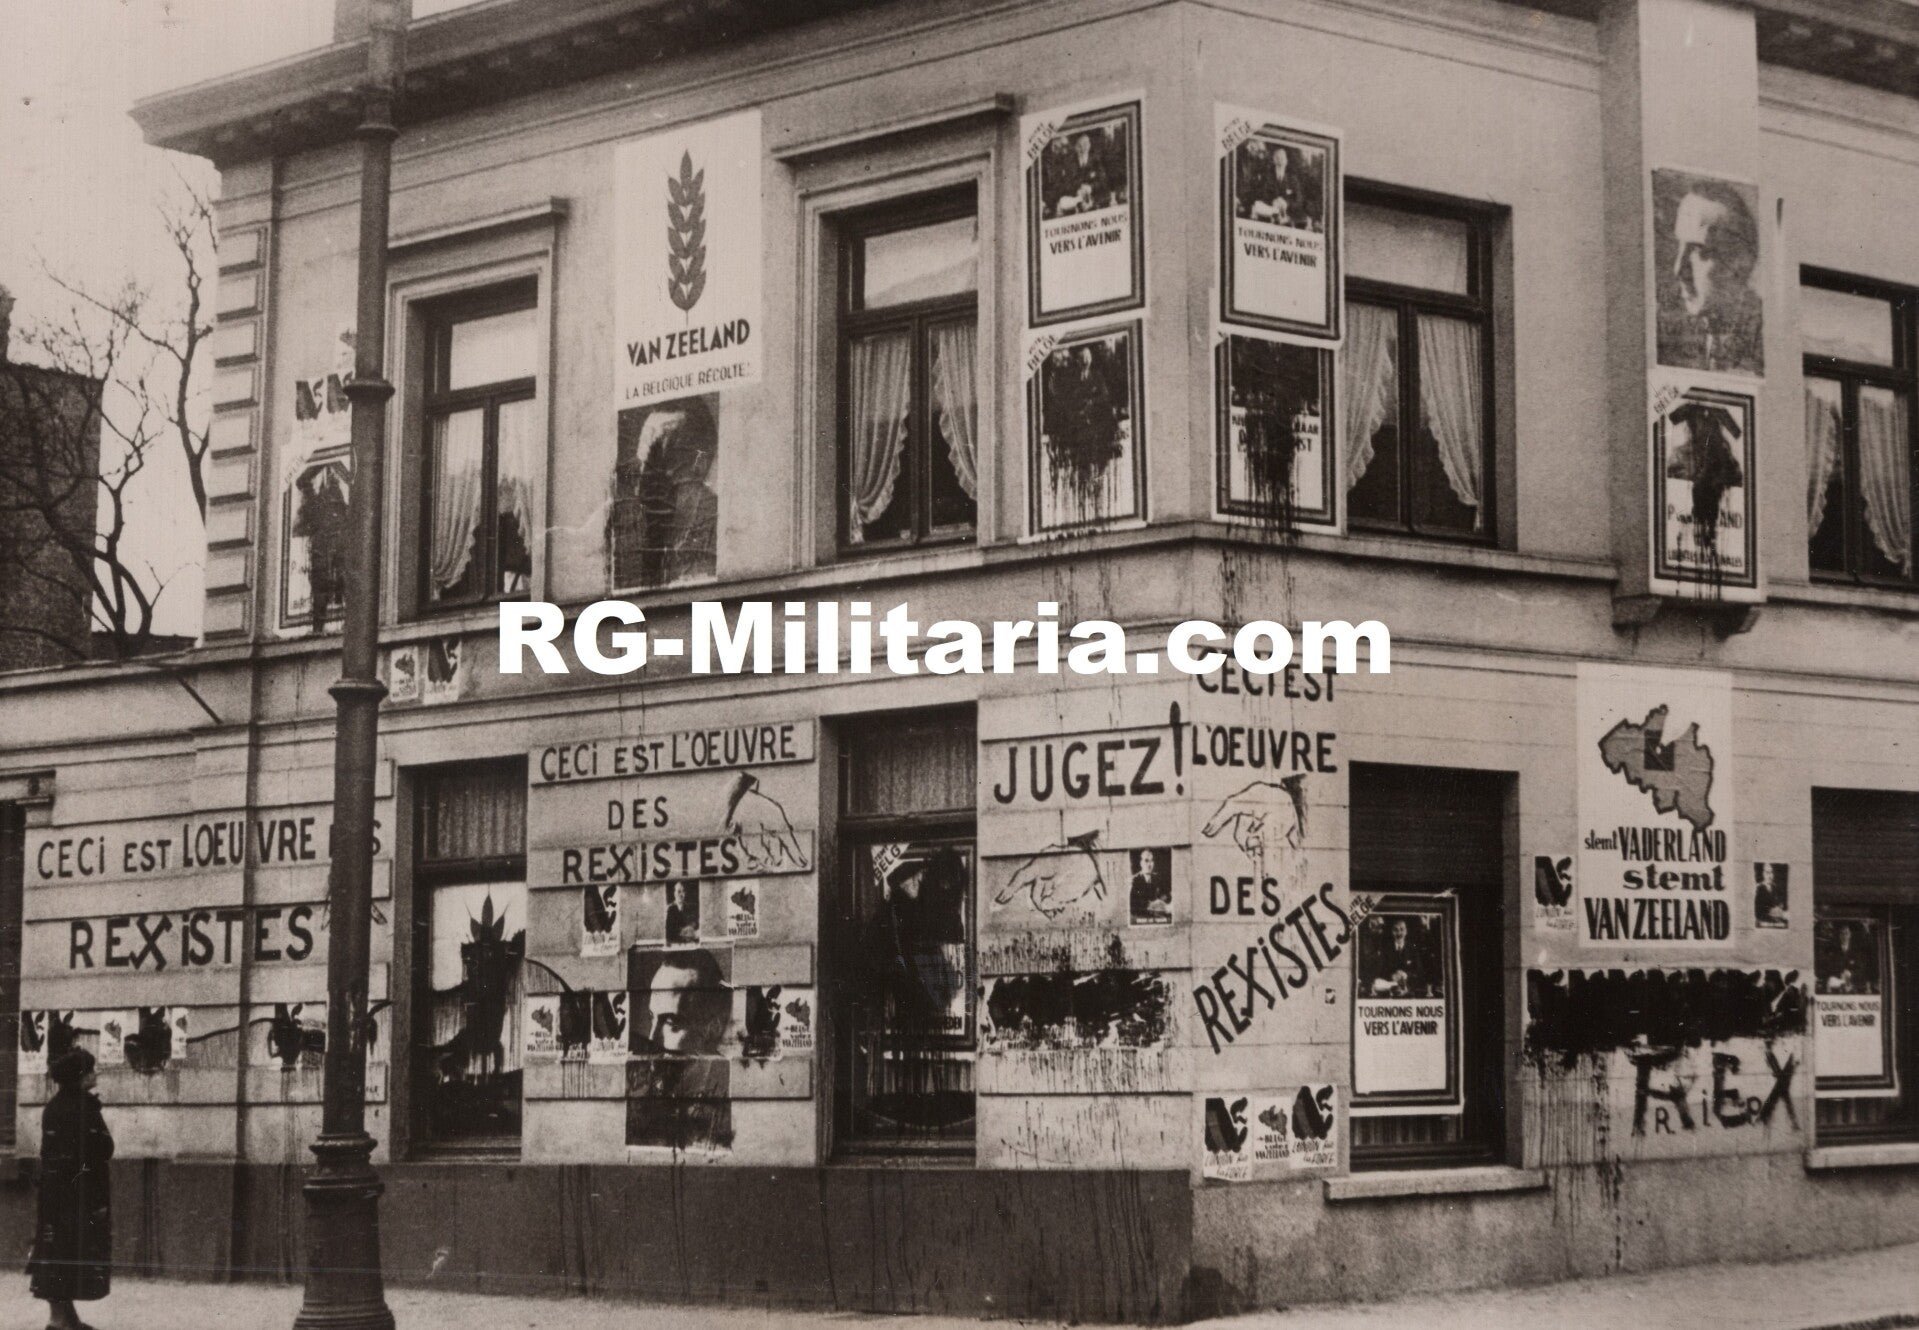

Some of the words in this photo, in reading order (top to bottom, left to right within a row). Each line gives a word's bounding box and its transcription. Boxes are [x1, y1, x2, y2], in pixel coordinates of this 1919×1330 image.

[1044, 220, 1098, 239] TOURNONS
[1049, 239, 1076, 255] VERS
[1077, 228, 1122, 251] L'AVENIR
[1238, 226, 1294, 246] TOURNONS
[1243, 242, 1271, 259] VERS
[1272, 247, 1318, 268] L'AVENIR
[626, 336, 662, 367] VAN
[664, 318, 751, 360] ZEELAND
[625, 386, 640, 400] LA
[642, 372, 693, 397] BELGIQUE
[1284, 663, 1337, 702] EST
[613, 741, 664, 774] EST
[671, 724, 797, 769] L'OEUVRE
[1191, 724, 1339, 774] L'OEUVRE
[608, 796, 669, 831] DES
[123, 839, 172, 873] EST
[1584, 828, 1618, 851] stemt
[1618, 825, 1727, 863] VADERLAND
[1623, 863, 1726, 891] stemt
[1210, 875, 1281, 916] DES
[1583, 897, 1630, 940] VAN
[1631, 897, 1730, 941] ZEELAND
[1357, 1005, 1413, 1018] TOURNONS
[1416, 1006, 1444, 1018] NOUS
[1858, 1001, 1880, 1011] NOUS
[1364, 1021, 1389, 1036] VERS
[1392, 1021, 1439, 1036] L'AVENIR
